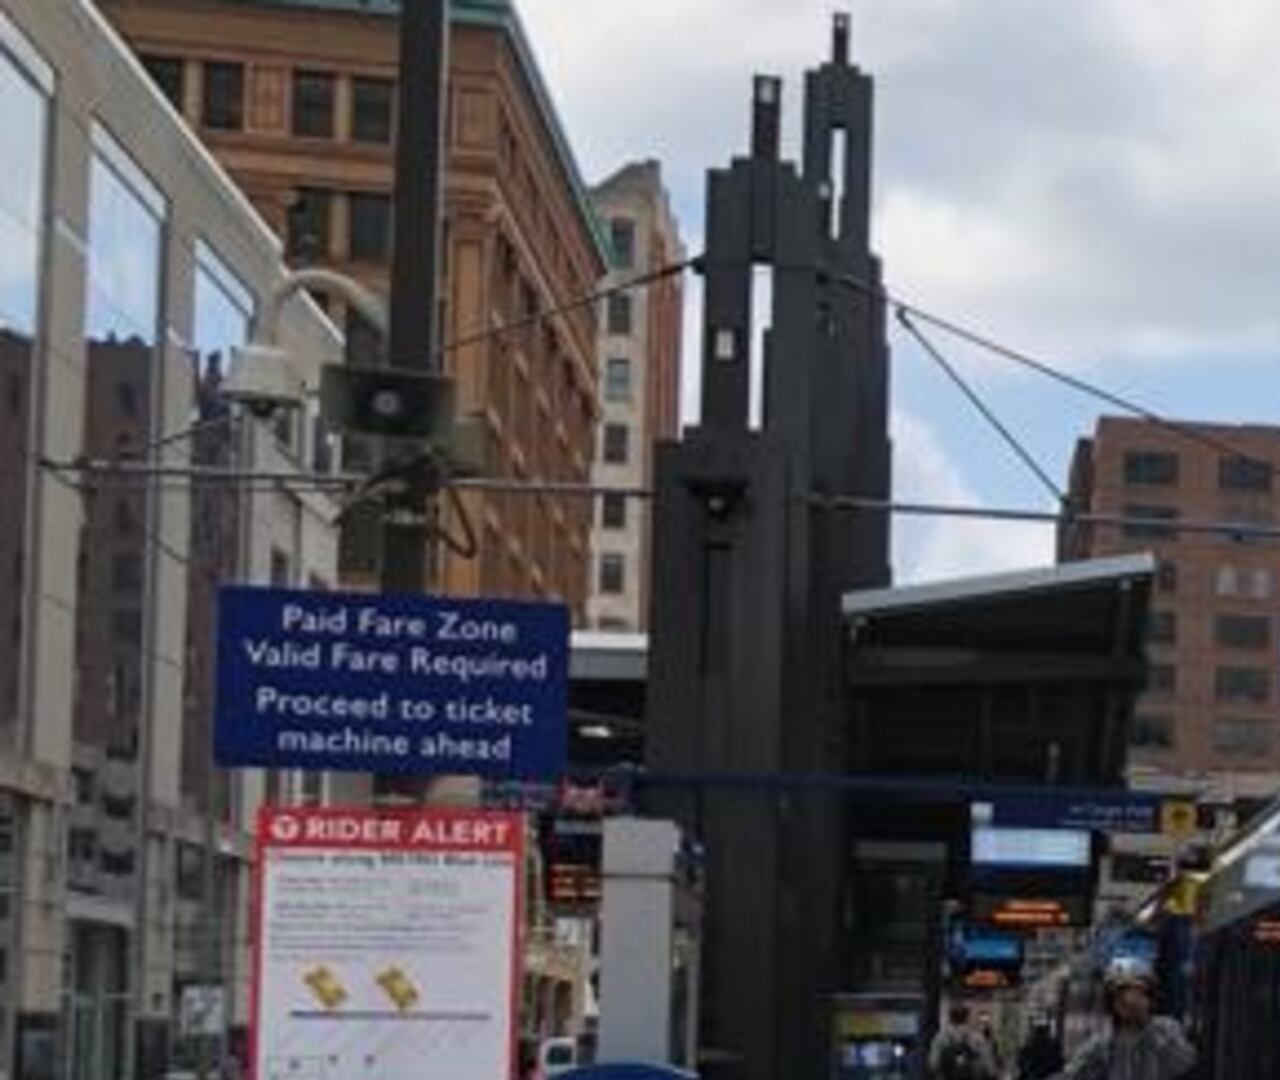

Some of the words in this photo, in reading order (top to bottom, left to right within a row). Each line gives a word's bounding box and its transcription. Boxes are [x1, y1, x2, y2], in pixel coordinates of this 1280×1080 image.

[282, 605, 348, 634] Paid
[358, 608, 426, 638] Fare
[437, 612, 518, 641] Zone
[245, 638, 321, 669] Valid
[331, 644, 399, 673] Fare
[411, 648, 548, 682] Required
[256, 687, 390, 719] Proceed
[401, 698, 435, 721] to
[446, 699, 533, 725] ticket
[278, 728, 410, 757] machine
[419, 732, 513, 761] ahead
[305, 817, 402, 841] RIDER
[412, 820, 512, 844] ALERT
